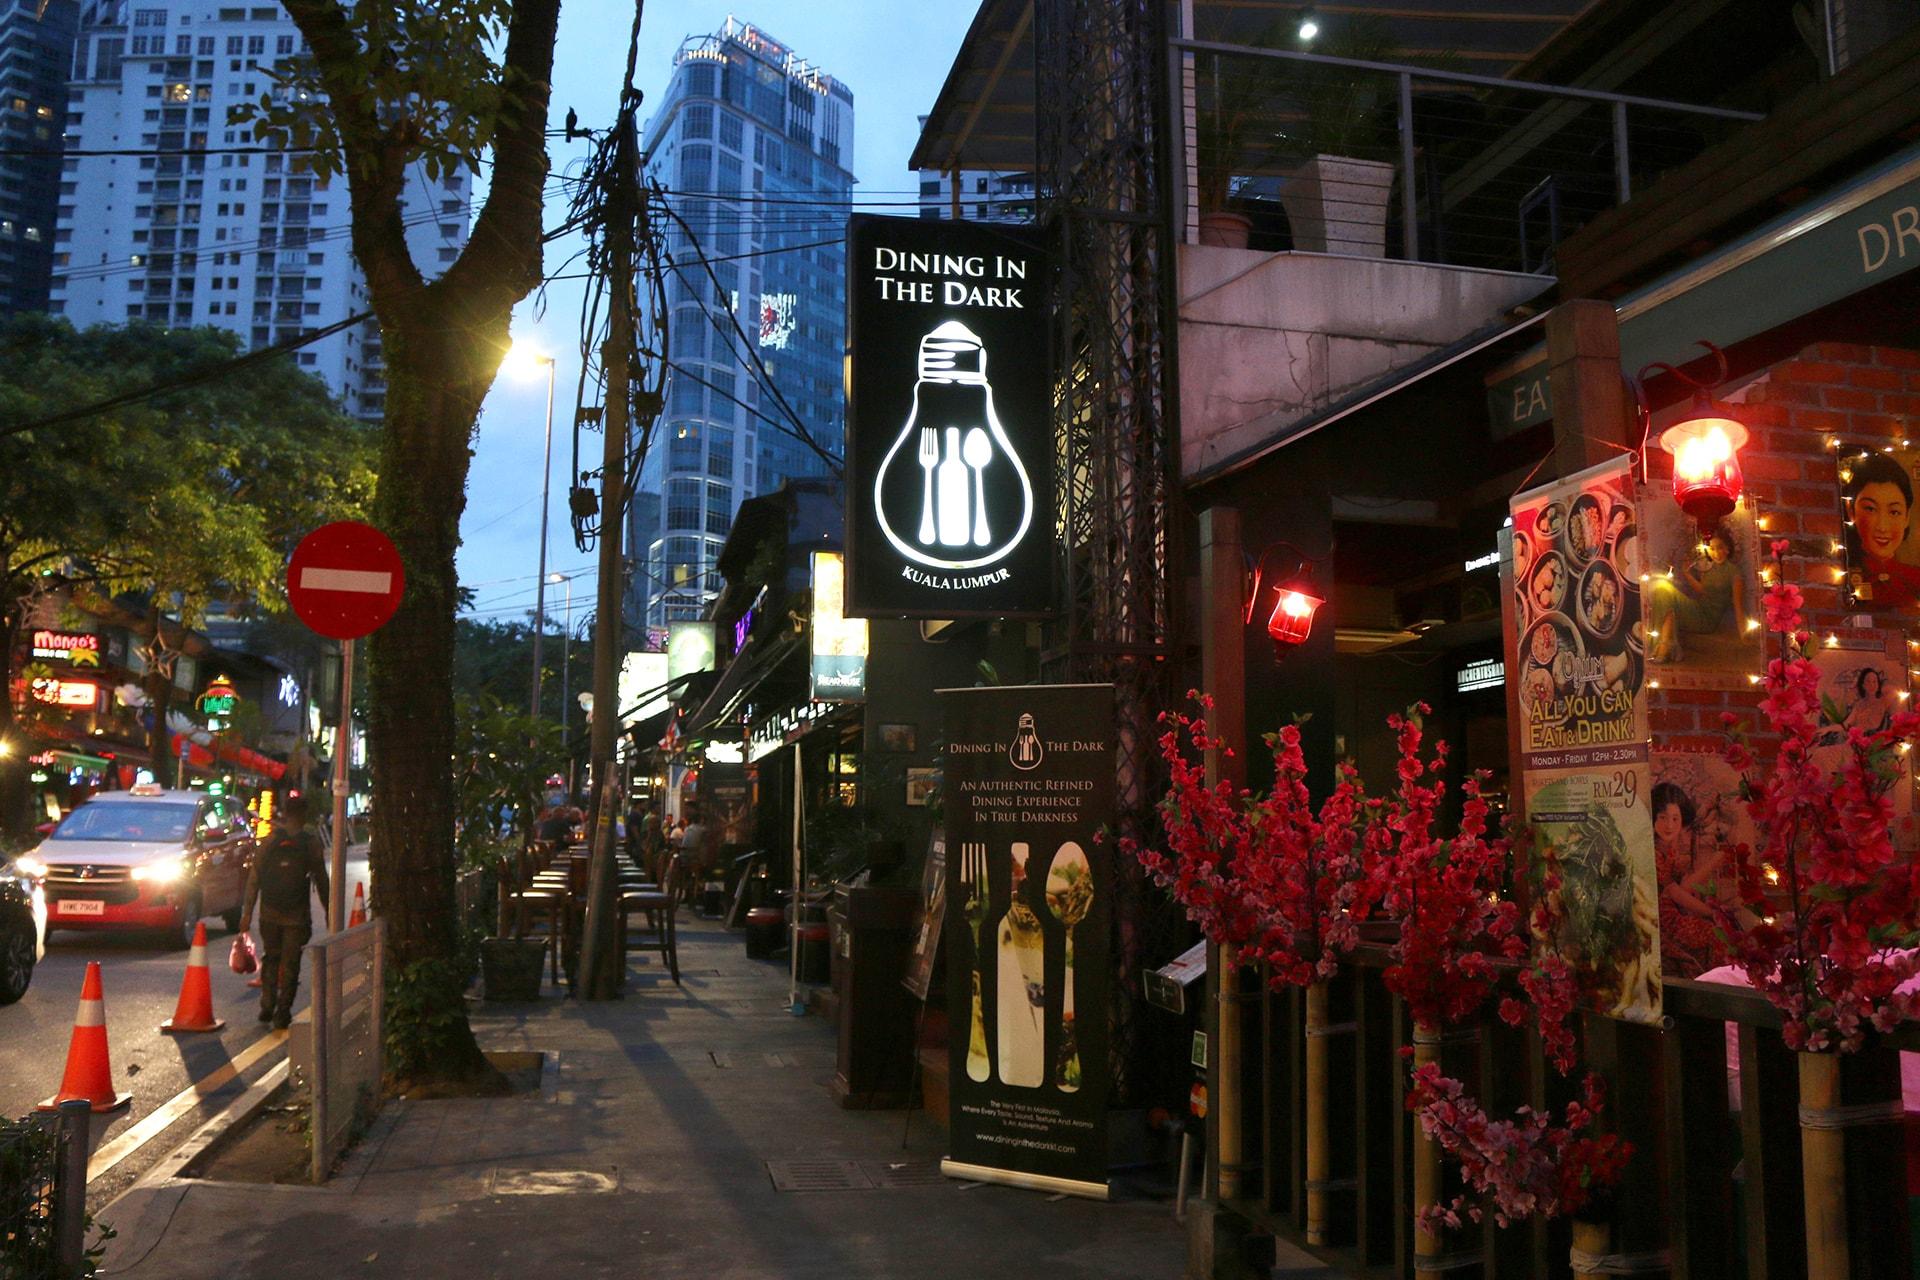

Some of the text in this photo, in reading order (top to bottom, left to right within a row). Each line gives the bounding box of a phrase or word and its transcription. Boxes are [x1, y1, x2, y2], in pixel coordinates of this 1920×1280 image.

[875, 247, 1026, 280] DINING IN
[874, 276, 1024, 309] THE DARK
[1513, 376, 1550, 421] EA
[901, 565, 1011, 590] KUALA LUMPUR
[1530, 688, 1633, 721] ALL YOU CAN
[1530, 714, 1635, 749] EAT & DRINK!
[950, 742, 1007, 754] DINING IN
[1046, 740, 1105, 752] THE DARK
[960, 779, 1094, 791] AN AUTHENTIC REFINED
[971, 795, 1081, 807] DINING EXPERIENCE
[975, 811, 1078, 823] IN TRUE DARKNESS
